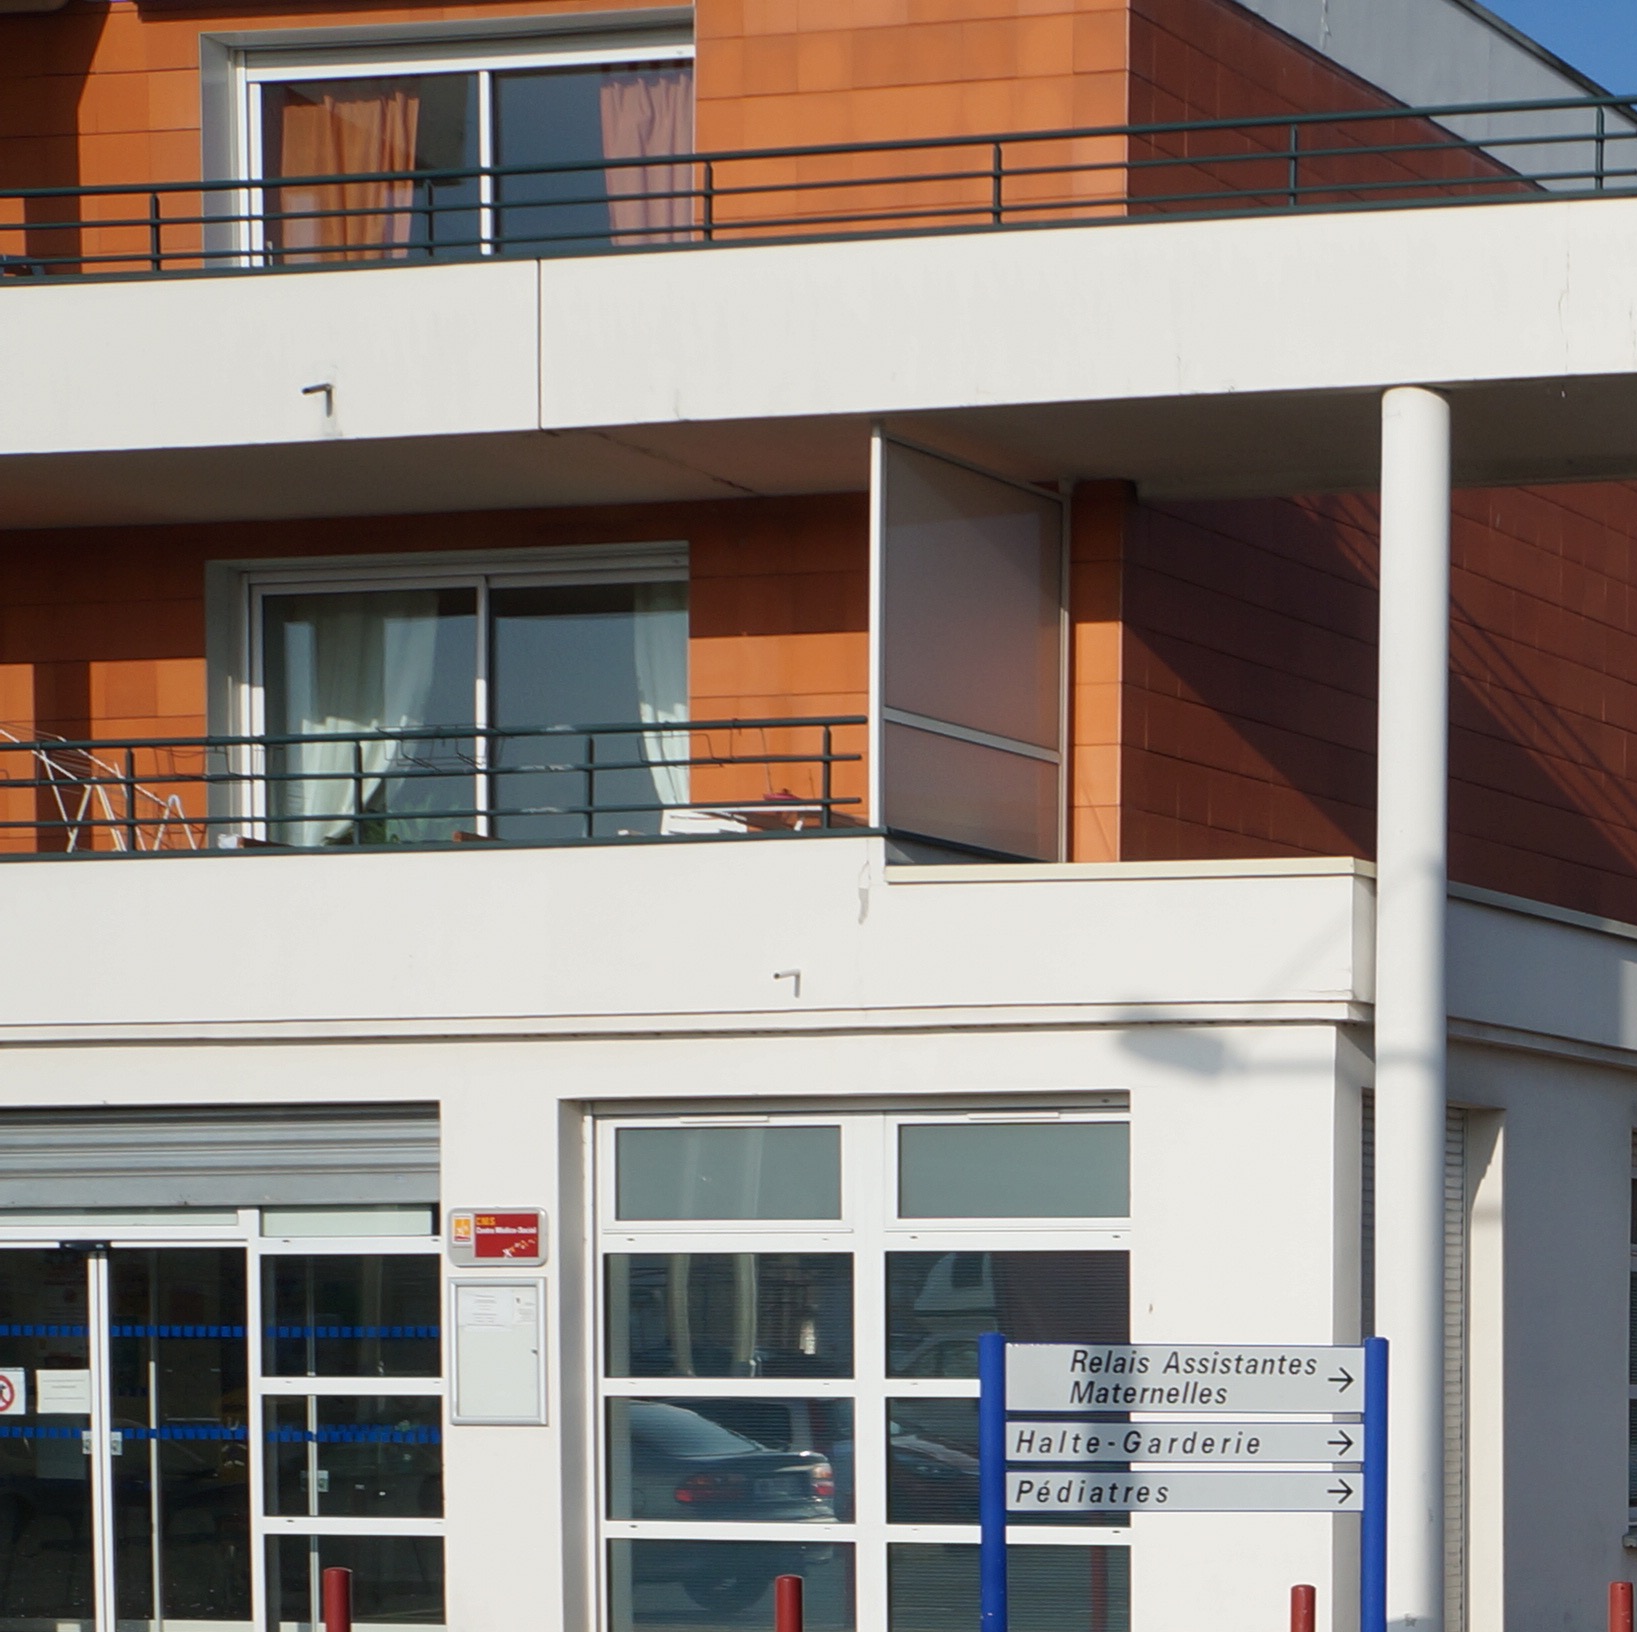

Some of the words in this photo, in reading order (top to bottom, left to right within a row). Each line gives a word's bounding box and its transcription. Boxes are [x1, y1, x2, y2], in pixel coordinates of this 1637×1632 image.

[1069, 1349, 1150, 1375] Relais
[1162, 1351, 1318, 1376] Assistantes
[1069, 1380, 1228, 1405] Maternelles
[1015, 1429, 1261, 1455] Halte-Garderie
[1015, 1479, 1169, 1504] Pédiatres
